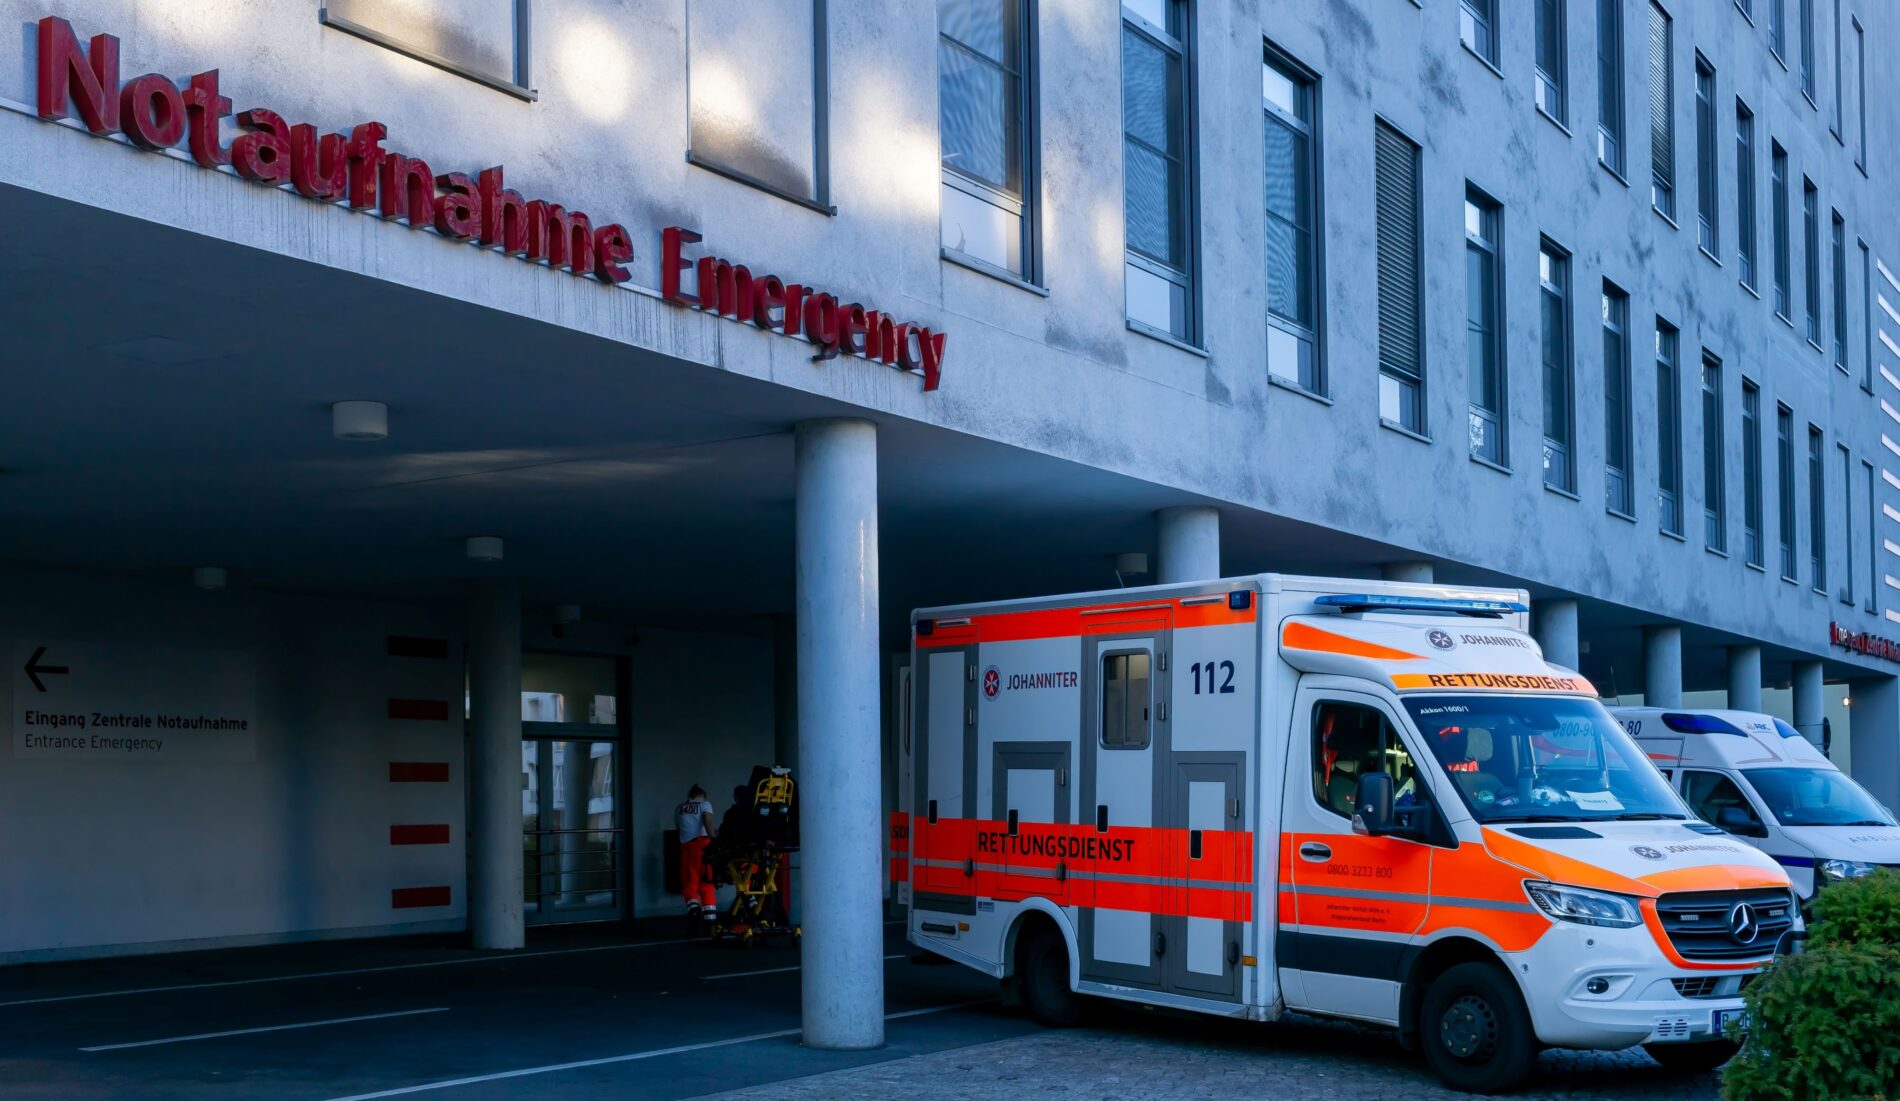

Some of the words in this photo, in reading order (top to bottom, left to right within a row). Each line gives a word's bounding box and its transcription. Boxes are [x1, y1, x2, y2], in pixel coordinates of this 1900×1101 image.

[37, 15, 635, 285] Notaufnahme
[661, 225, 948, 392] Emergency
[1006, 671, 1079, 690] JOHANNITER
[1190, 659, 1236, 695] 112
[1427, 673, 1578, 692] RETTUNGSDIENST
[1420, 706, 1444, 715] Akkon
[1444, 705, 1470, 713] 1600/1
[25, 710, 86, 730] Eingang
[91, 712, 152, 728] Zentrale
[157, 714, 248, 731] Notaufnahme
[25, 733, 86, 749] Entrance
[90, 734, 163, 752] Emergency
[977, 831, 1136, 862] RETTUNGSDIENST
[1327, 863, 1349, 876] 0800
[1351, 865, 1373, 877] 3233
[1375, 866, 1393, 879] 800
